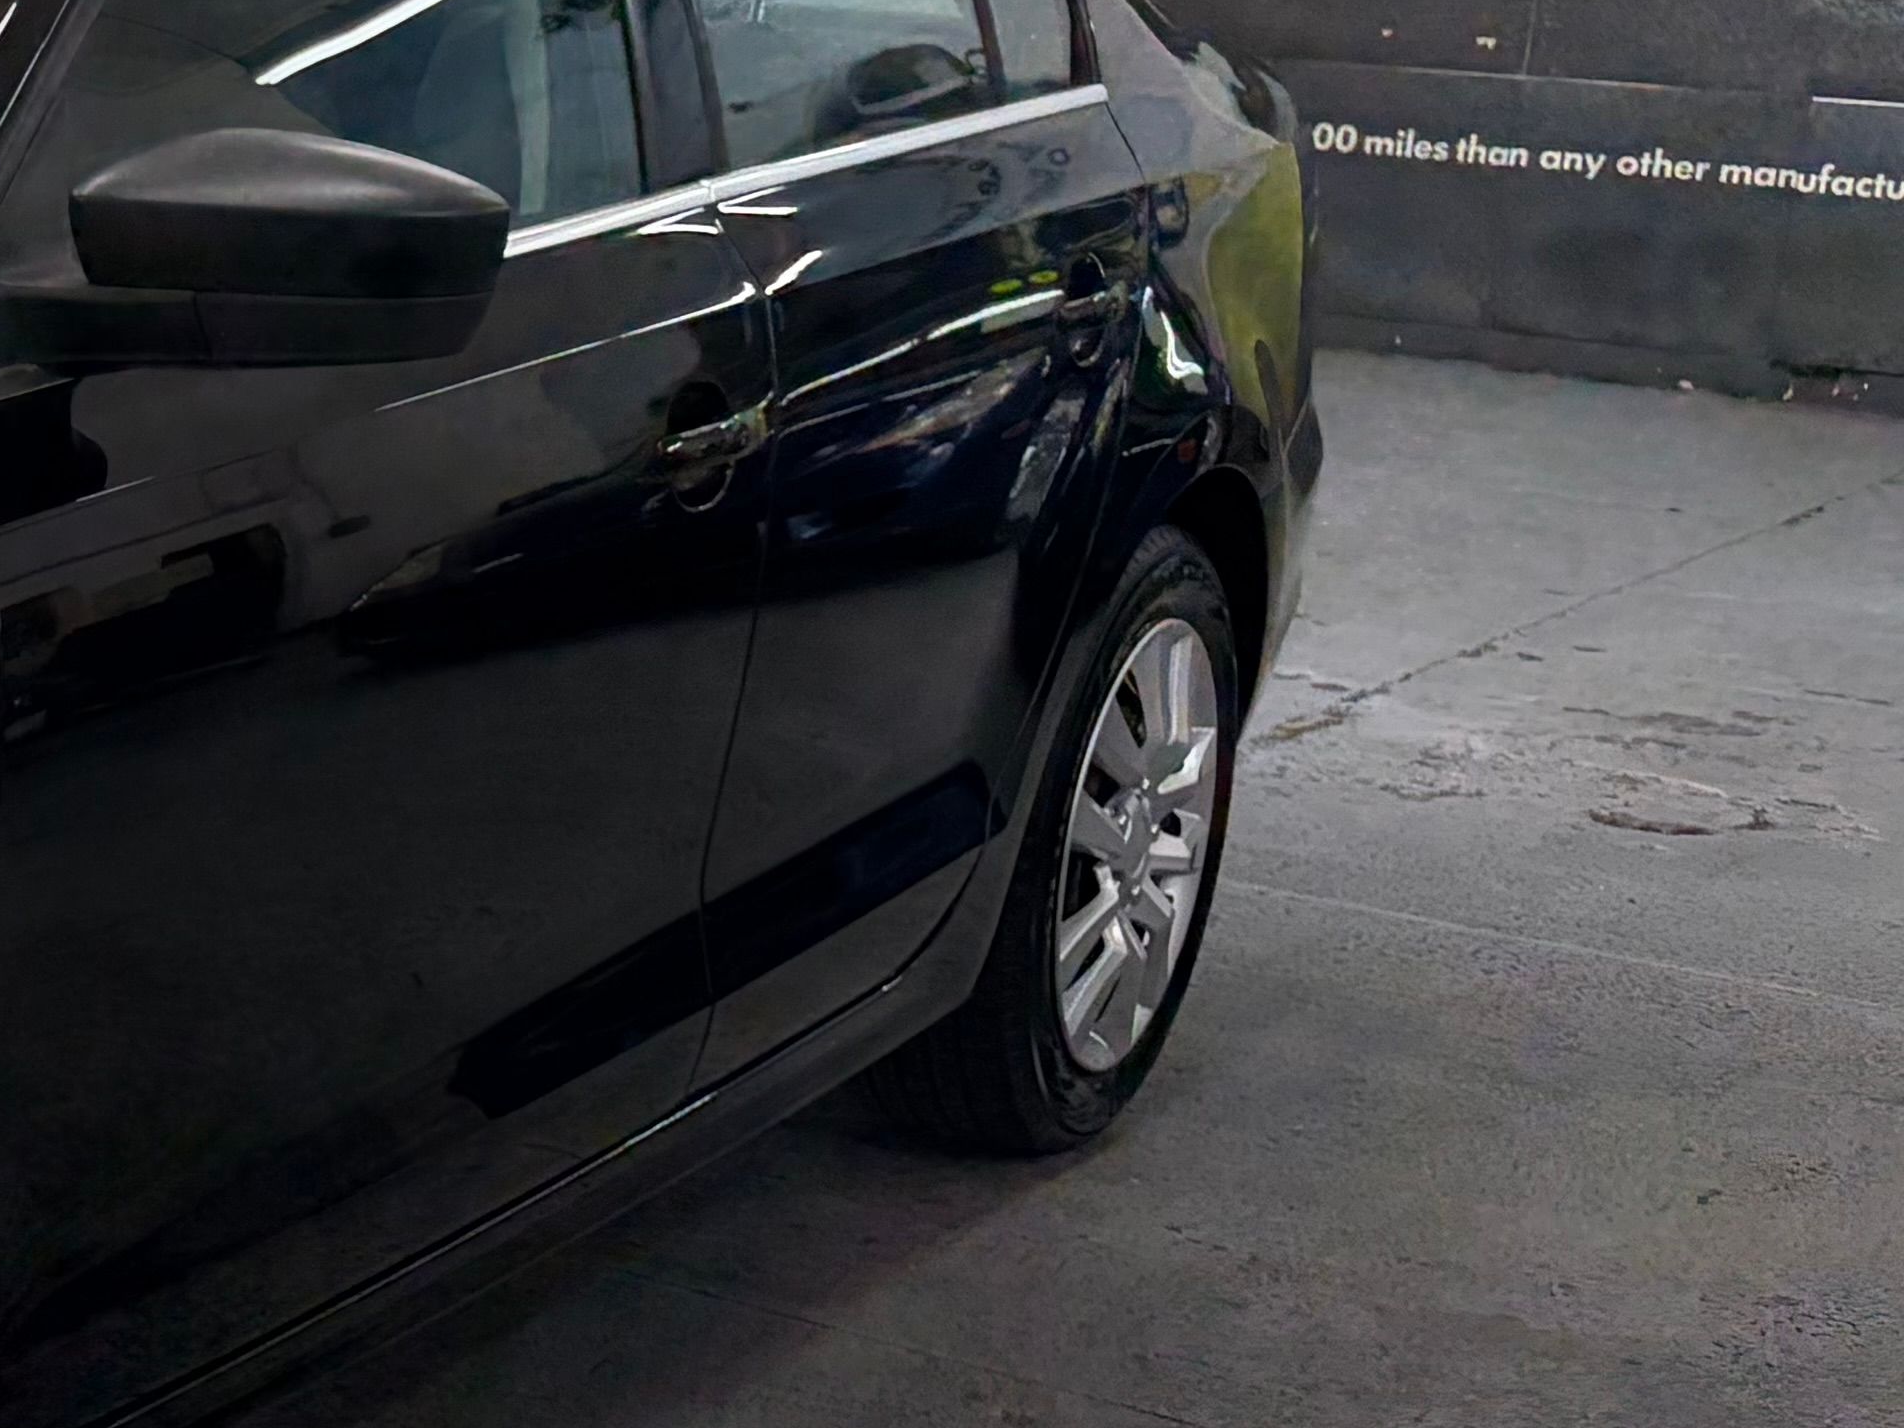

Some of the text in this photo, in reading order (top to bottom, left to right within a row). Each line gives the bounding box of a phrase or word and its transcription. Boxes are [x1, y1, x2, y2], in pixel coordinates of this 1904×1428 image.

[1363, 127, 1449, 163] miles
[1456, 133, 1530, 170] than
[1539, 147, 1607, 181] any
[1617, 151, 1711, 185] other
[1718, 160, 1904, 201] manufactu
